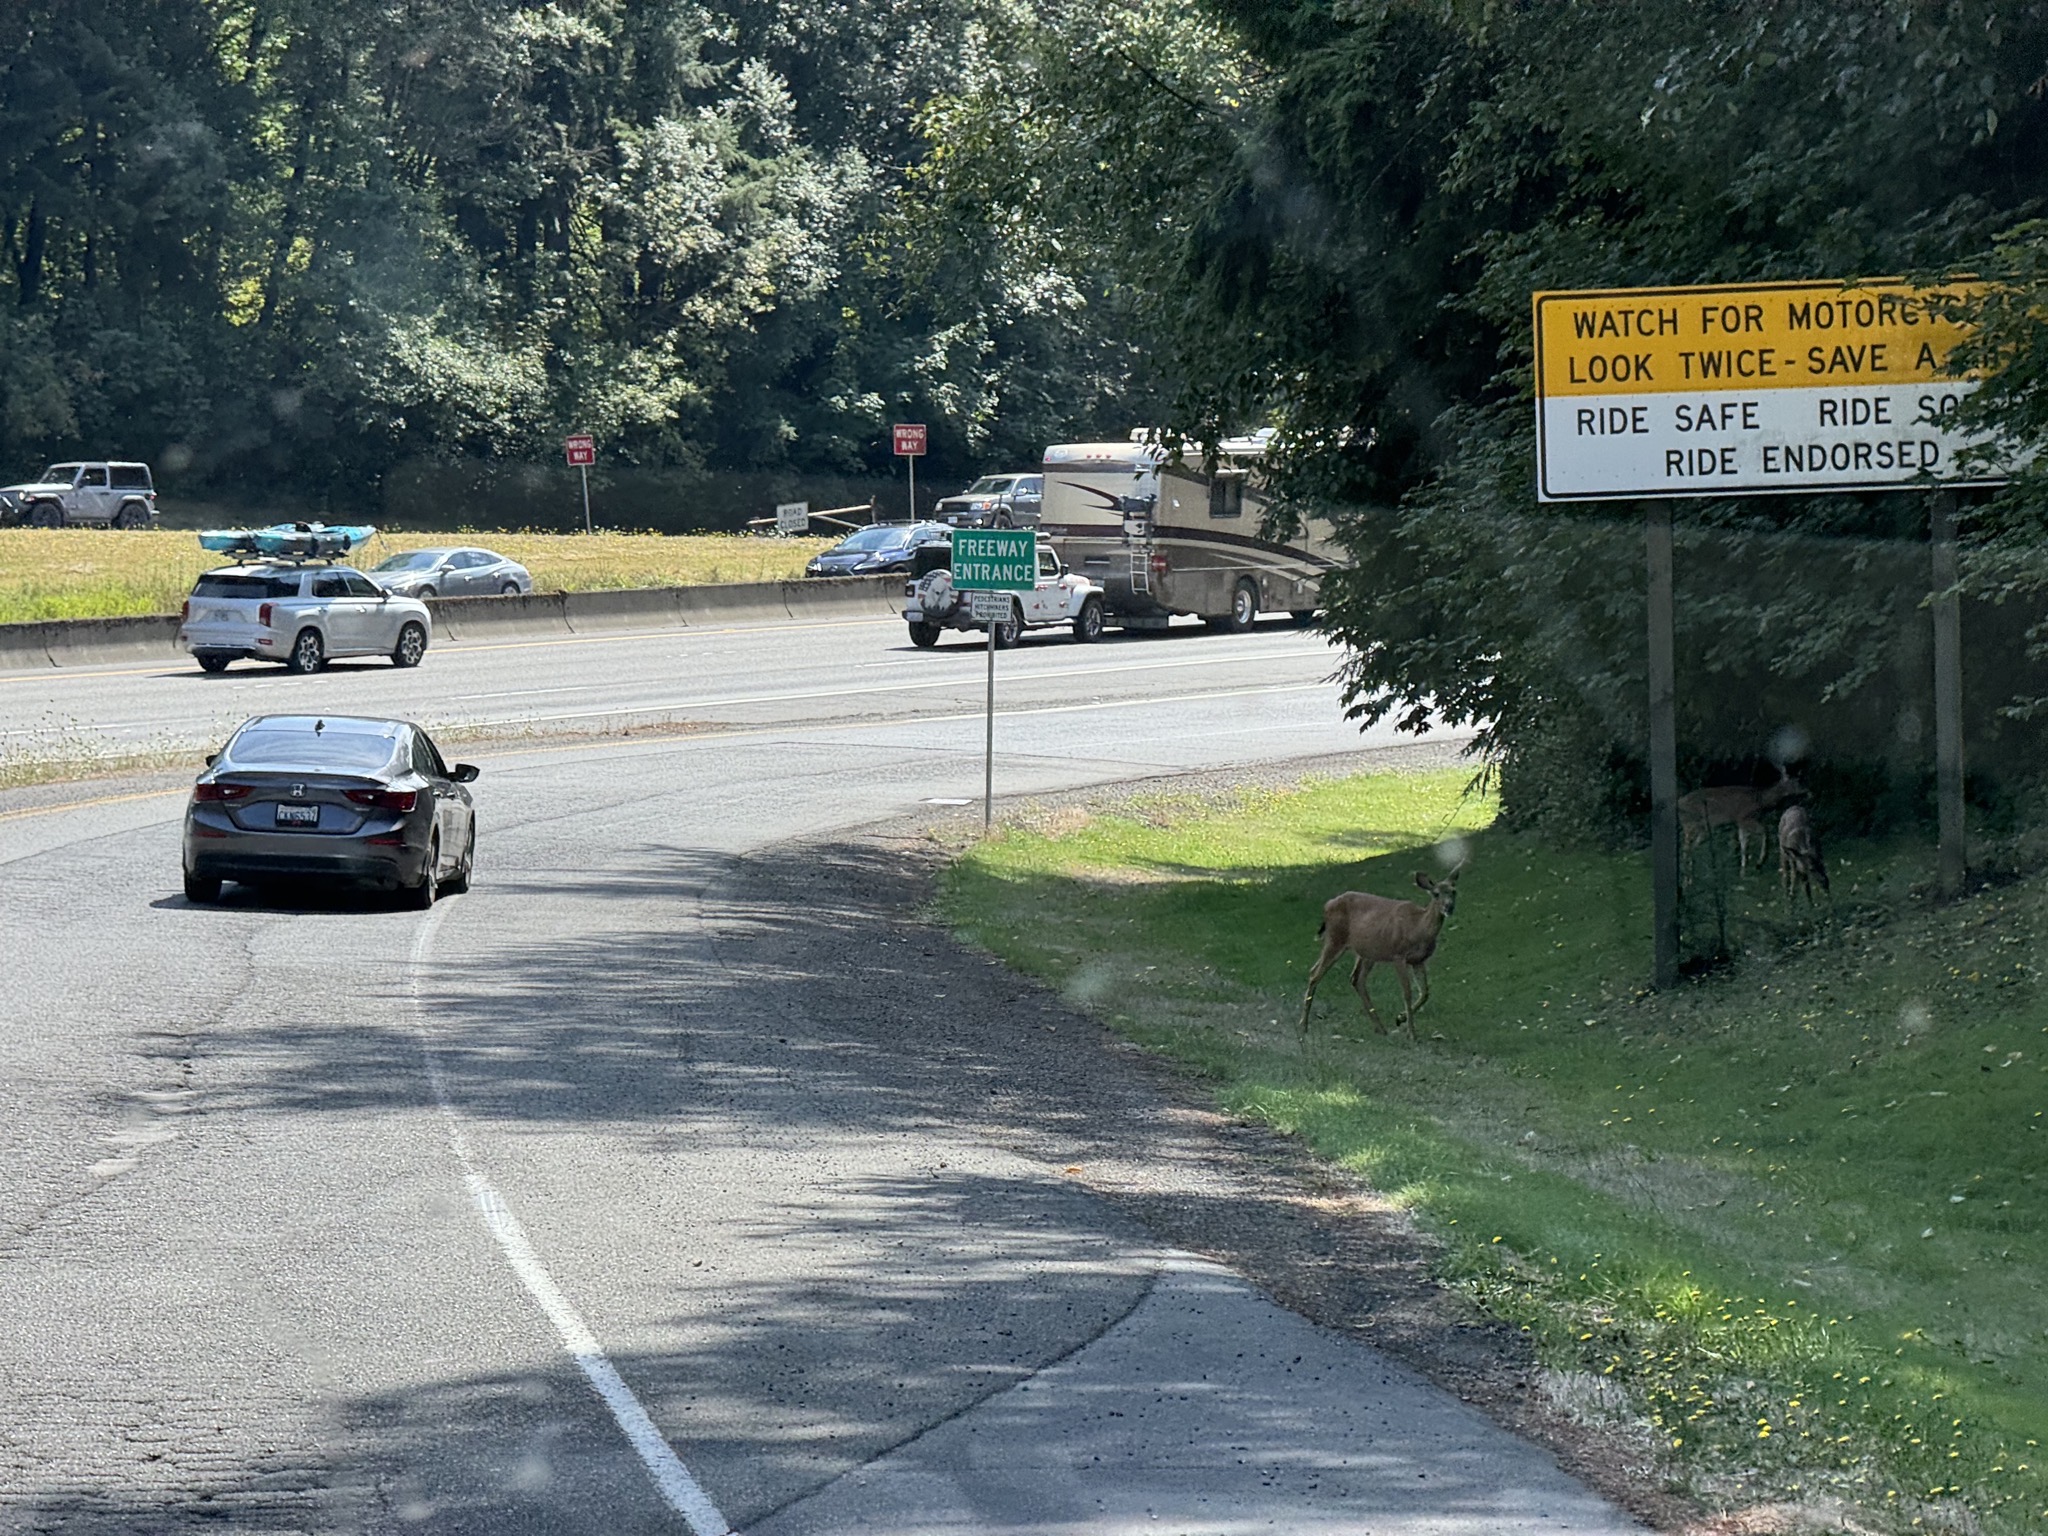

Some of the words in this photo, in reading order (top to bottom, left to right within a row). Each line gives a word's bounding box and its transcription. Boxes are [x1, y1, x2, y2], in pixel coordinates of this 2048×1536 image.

[1573, 308, 1679, 339] WATCH
[1702, 305, 1765, 335] FOR
[1569, 353, 1654, 384] LOOK
[1914, 342, 1937, 370] A
[1576, 407, 1650, 436] RIDE
[1675, 402, 1761, 432] SAFE
[1819, 397, 1892, 427] RIDE
[896, 428, 925, 440] WRONG
[568, 439, 592, 449] WRONG
[901, 440, 919, 451] WAY
[573, 451, 588, 461] WAY
[1666, 447, 1738, 477] RIDE
[1762, 440, 1941, 474] ENDORSED
[783, 507, 803, 518] ROAD
[780, 518, 806, 530] CLOSED
[958, 539, 1028, 558] FREEWAY
[953, 563, 1033, 582] ENTRANCE
[974, 595, 1010, 604] PEDESTRIANS
[975, 611, 1008, 619] PROHIBITED
